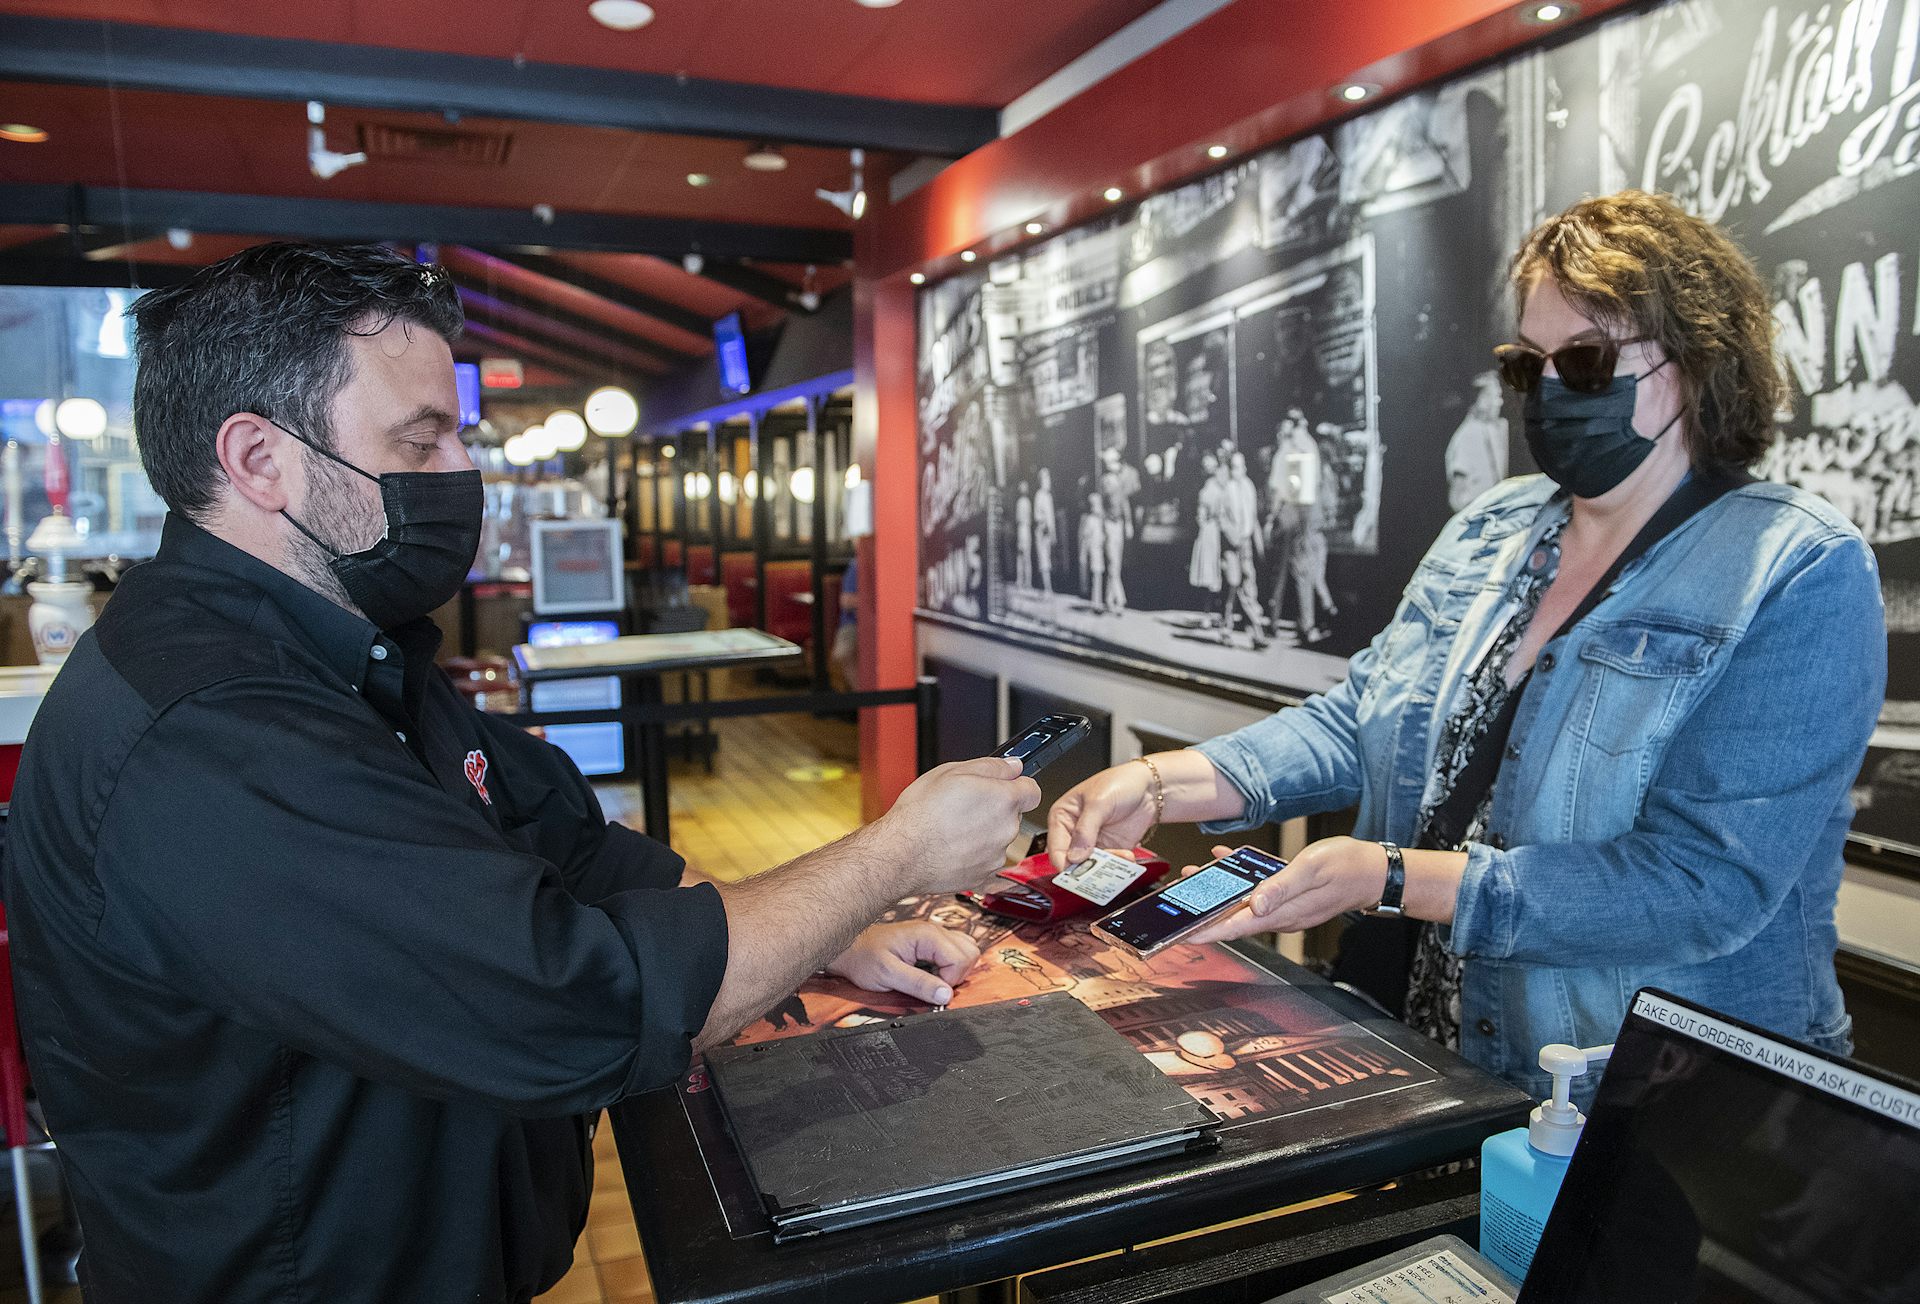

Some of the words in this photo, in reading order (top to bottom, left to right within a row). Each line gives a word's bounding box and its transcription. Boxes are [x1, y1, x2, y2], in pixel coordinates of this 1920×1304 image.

[1636, 999, 1668, 1021] TAKE
[1669, 1012, 1697, 1033] OUT
[1697, 1023, 1754, 1056] ORDERS
[1755, 1047, 1816, 1080] ALWAYS
[1817, 1071, 1849, 1093] ASK
[1851, 1082, 1867, 1099] IF
